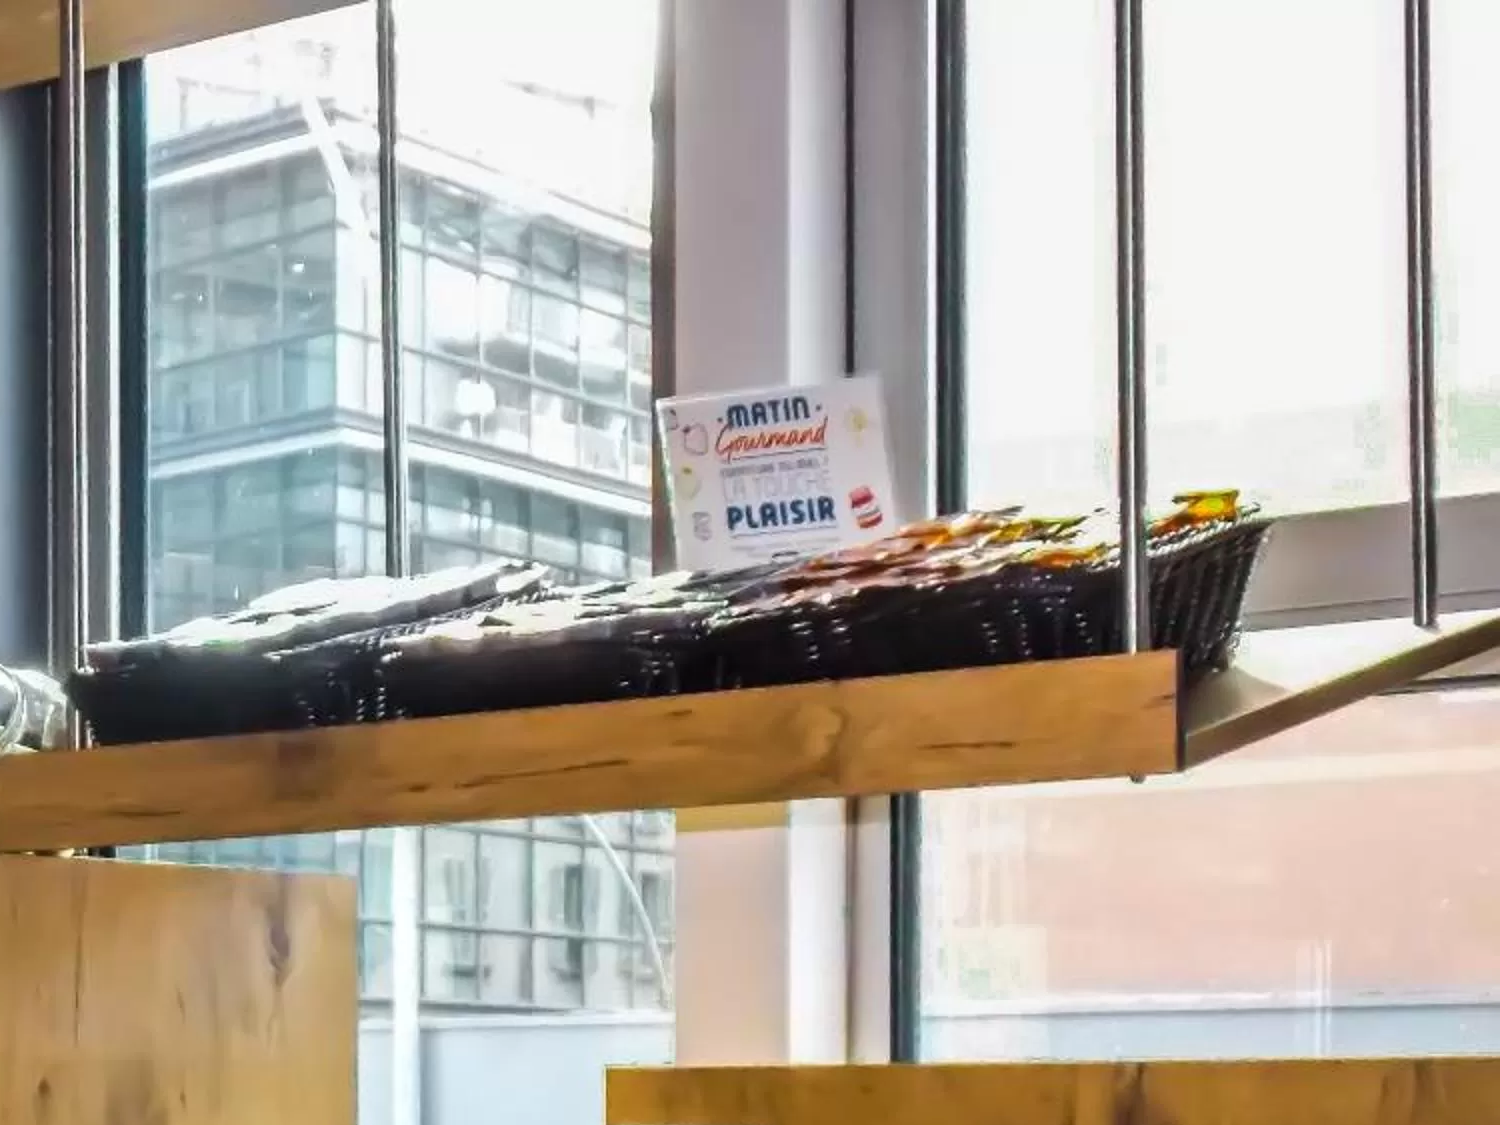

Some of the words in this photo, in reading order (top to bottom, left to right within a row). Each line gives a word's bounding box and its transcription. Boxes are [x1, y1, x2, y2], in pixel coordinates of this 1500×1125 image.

[727, 396, 810, 427] MATIN
[715, 415, 829, 464] Gourmand
[727, 495, 837, 531] PLAISIR
